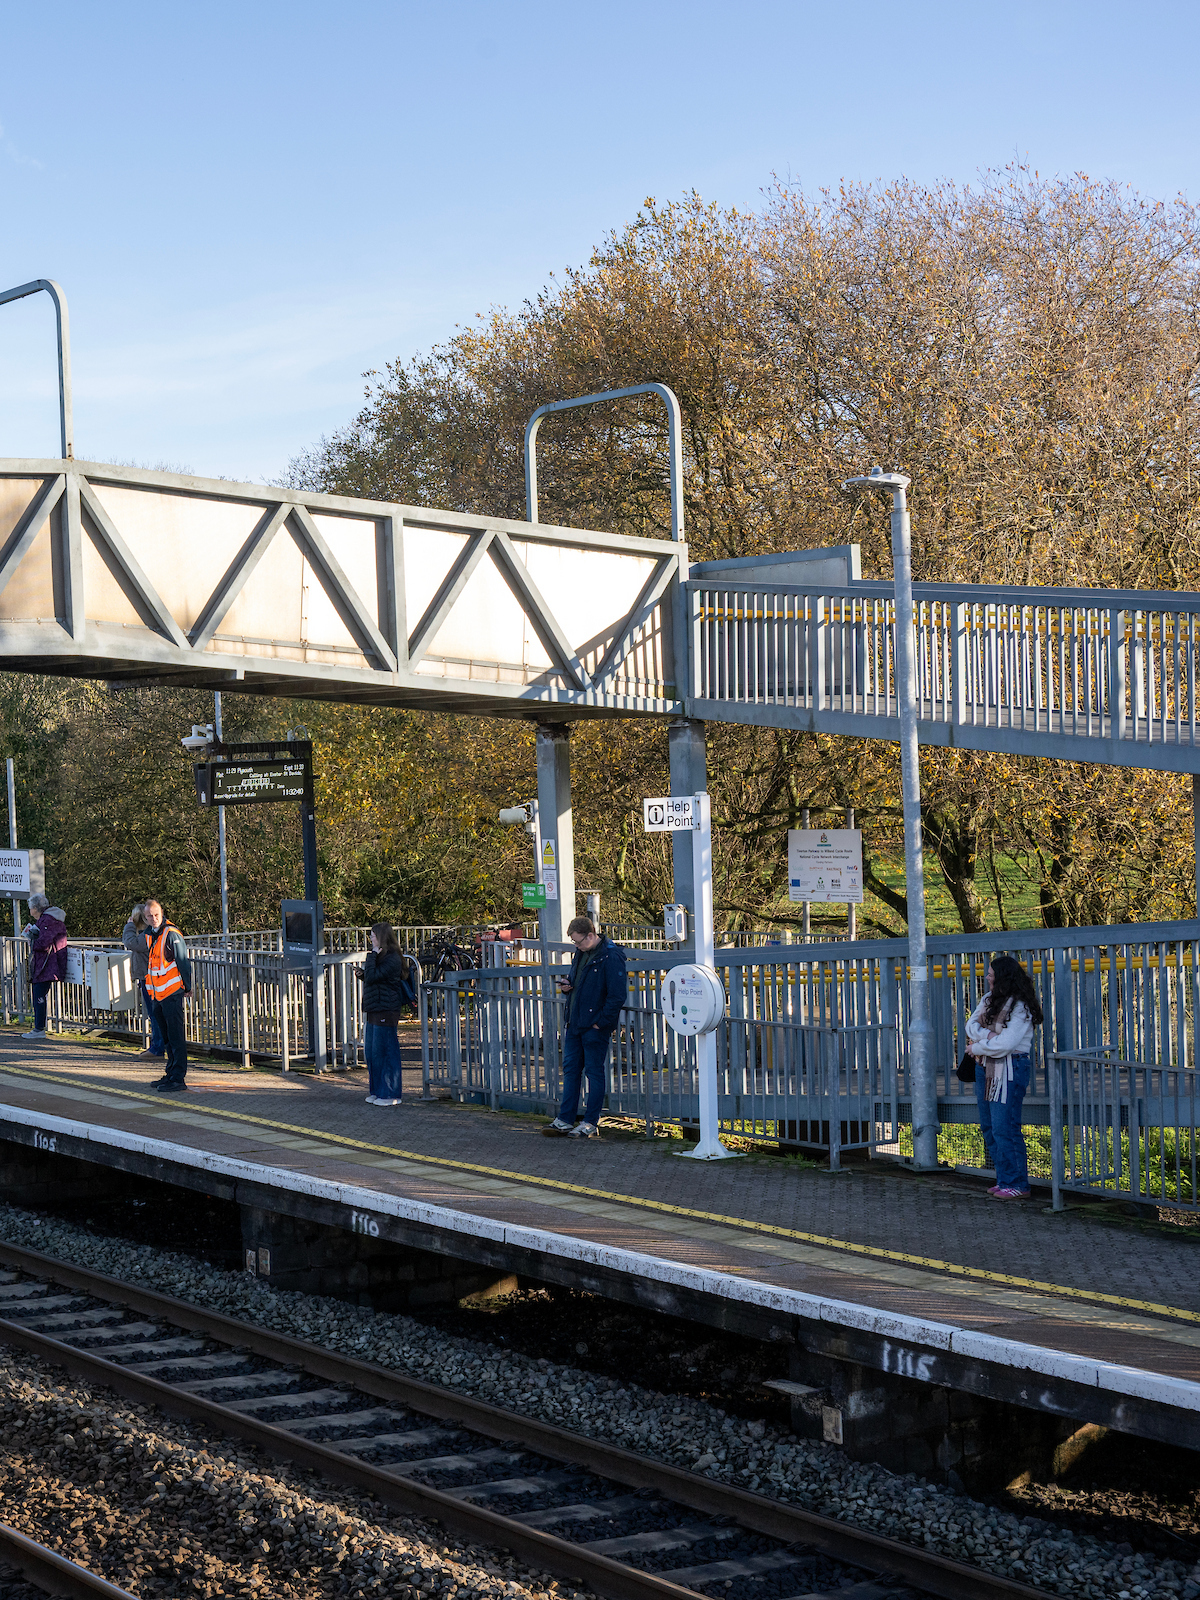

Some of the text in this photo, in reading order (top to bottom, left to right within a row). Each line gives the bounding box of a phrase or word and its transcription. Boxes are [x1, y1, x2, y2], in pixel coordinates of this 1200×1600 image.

[667, 800, 690, 814] Help
[668, 815, 693, 826] Point
[678, 988, 689, 996] Help
